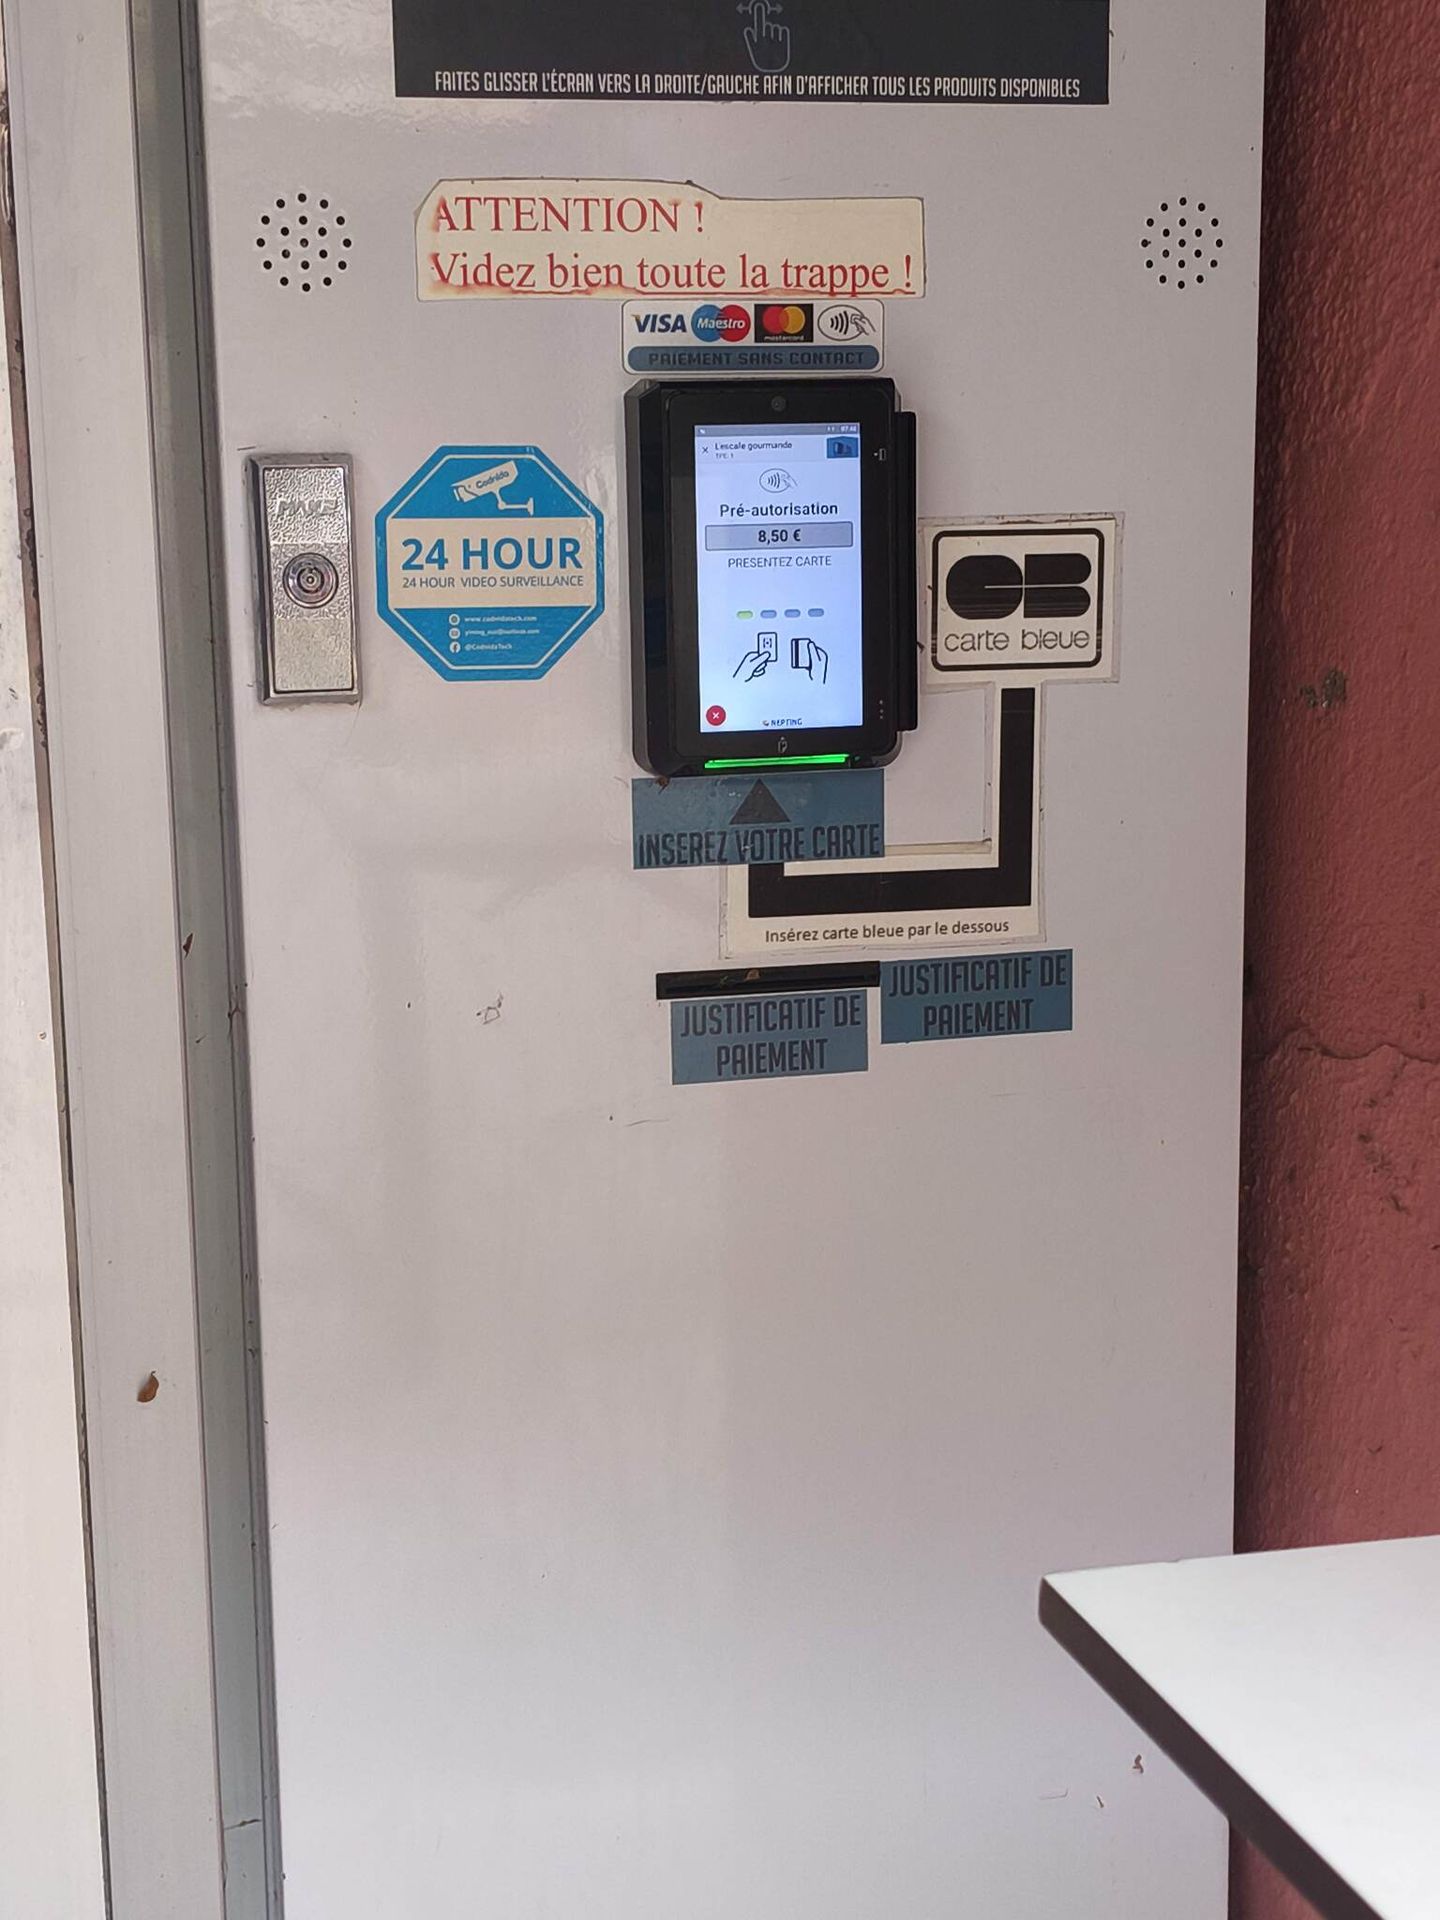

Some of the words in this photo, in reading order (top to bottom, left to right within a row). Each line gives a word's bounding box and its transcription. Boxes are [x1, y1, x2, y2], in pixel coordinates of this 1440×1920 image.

[434, 71, 480, 92] FAITES
[484, 71, 538, 93] GLISSER
[542, 68, 594, 93] L'ÉCRAN
[598, 73, 631, 93] VERS
[635, 73, 651, 93] LA
[655, 74, 760, 95] DROITE/GAUCHE
[763, 75, 792, 95] AFIN
[797, 75, 868, 96] D'AFFICHER
[872, 76, 906, 96] TOUS
[909, 77, 931, 96] LES
[934, 77, 997, 97] PRODUITS
[1000, 78, 1080, 98] DISPONIBLES
[433, 196, 681, 233] ATTENTION
[696, 200, 704, 233] !
[431, 252, 536, 288] Videz
[548, 253, 623, 288] bien
[637, 256, 727, 288] toute
[739, 254, 769, 288] la
[781, 259, 890, 297] trappe
[904, 254, 912, 289] !
[631, 314, 687, 333] VISA
[697, 316, 746, 331] Maestro
[649, 352, 732, 366] PAIEMENT
[738, 352, 786, 365] SANS
[790, 351, 864, 365] CONTACT
[748, 440, 793, 451] gourmande
[720, 502, 838, 518] Pré-autorisation
[758, 529, 788, 545] 8,50
[793, 529, 802, 542] €
[401, 538, 449, 571] 24
[462, 537, 583, 570] HOUR
[728, 557, 793, 568] PRESENTEZ
[795, 555, 832, 566] CARTE
[402, 577, 417, 588] 24
[420, 576, 455, 588] HOUR
[461, 576, 497, 588] VIDEO
[500, 575, 584, 588] SURVEILLANCE
[944, 630, 1010, 652] carte
[1021, 629, 1090, 651] bleue
[638, 830, 728, 867] INSEREZ
[735, 827, 805, 864] VOTRE
[812, 823, 880, 859] CARTE
[765, 927, 819, 943] Insérez
[823, 926, 859, 940] carte
[863, 923, 904, 939] bleue
[907, 925, 932, 942] par
[935, 921, 949, 936] le
[951, 919, 1009, 935] dessous
[889, 956, 1031, 998] JUSTIFICATIF
[1041, 953, 1068, 987] DE
[680, 996, 826, 1038] JUSTIFICATIF
[834, 994, 862, 1029] DE
[923, 998, 1035, 1037] PAIEMENT
[716, 1038, 829, 1077] PAIEMENT
